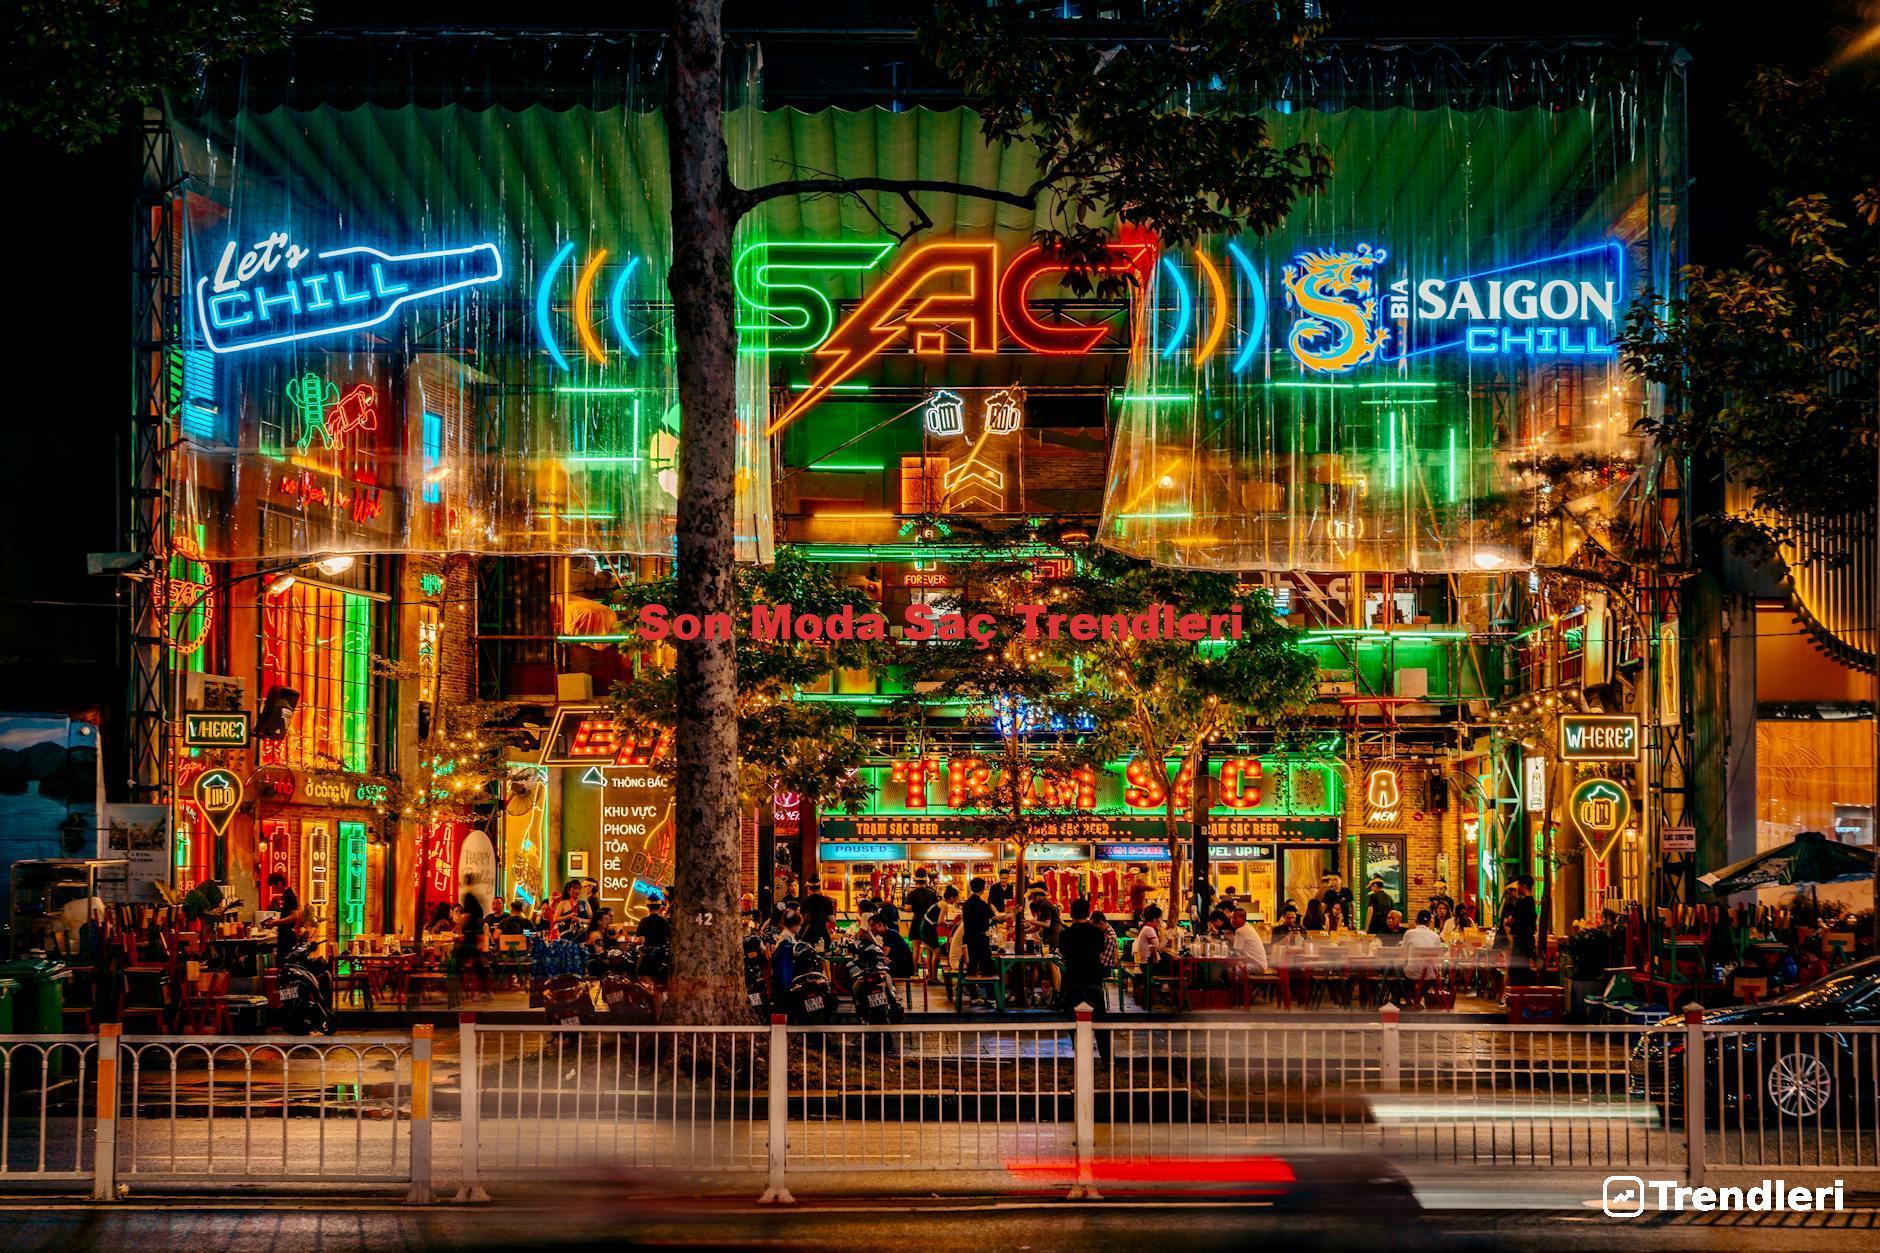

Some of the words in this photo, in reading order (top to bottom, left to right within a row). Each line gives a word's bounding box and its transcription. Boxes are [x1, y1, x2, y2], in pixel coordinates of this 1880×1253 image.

[214, 232, 309, 292] Let's
[208, 263, 408, 329] CHILL
[1391, 279, 1408, 319] BIA
[1418, 279, 1615, 320] SAIGON
[1466, 327, 1612, 353] CHILL
[905, 574, 947, 585] FOREVER
[1565, 726, 1635, 749] WHERE?
[611, 776, 646, 788] THÔNG
[604, 806, 629, 817] KHU
[631, 806, 657, 820] VỰC
[1370, 811, 1398, 822] MEN
[604, 824, 646, 835] PHONG
[912, 823, 939, 835] BEER
[1252, 823, 1279, 836] BEER
[1208, 846, 1232, 857] VEL
[603, 878, 629, 890] SẠC
[695, 912, 713, 926] 42
